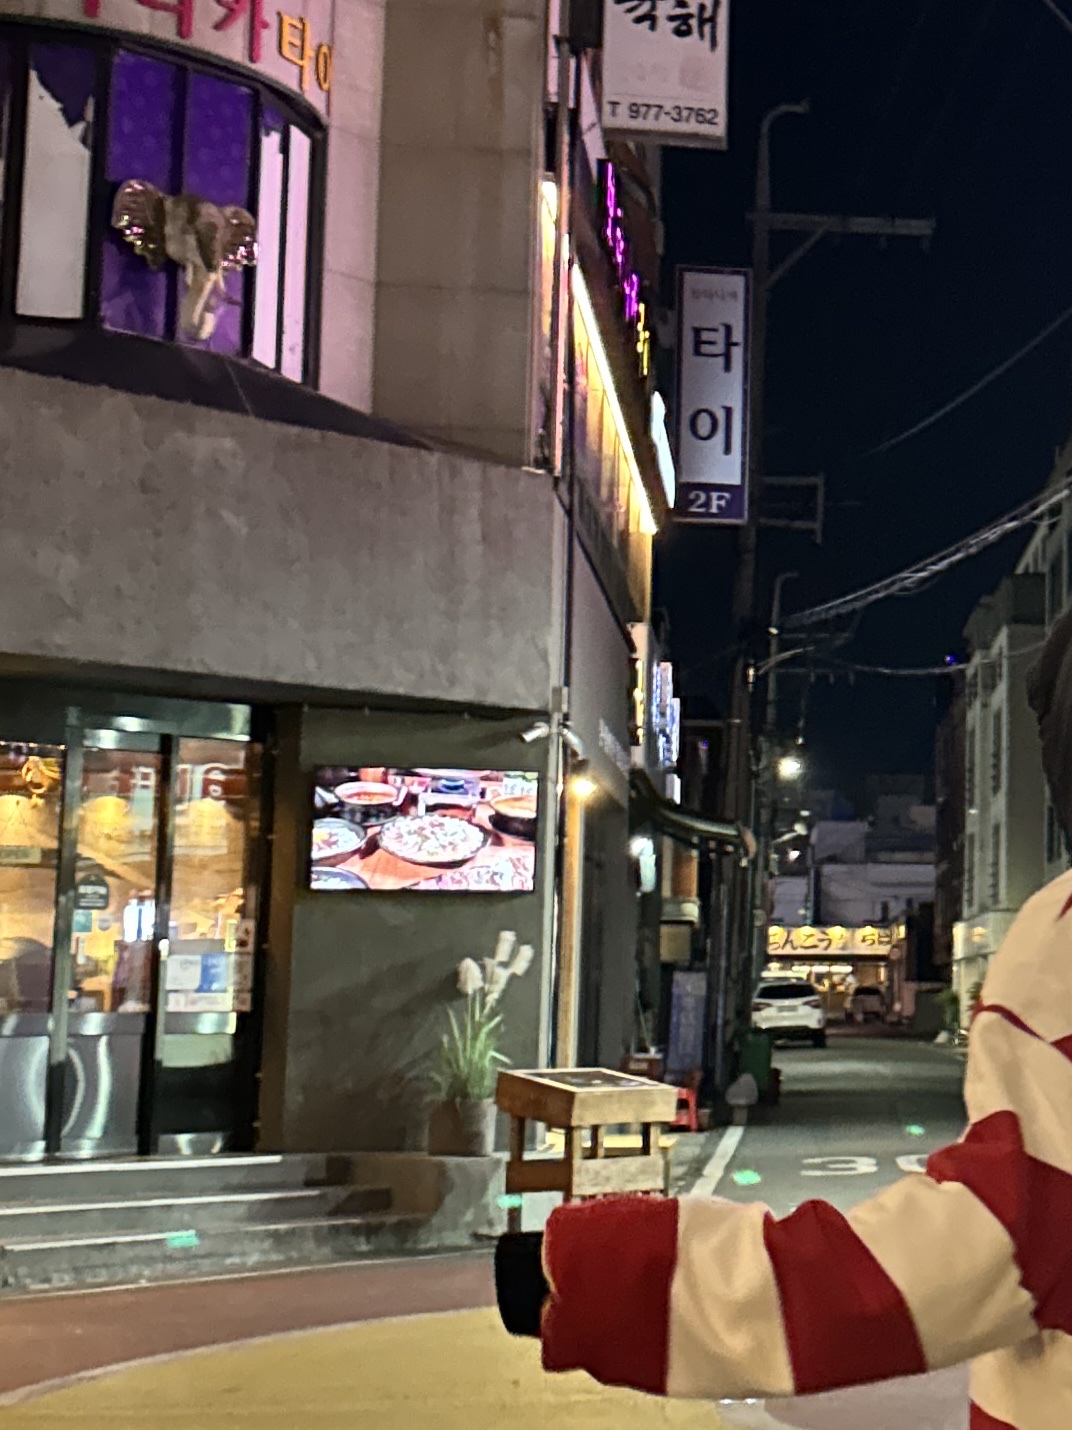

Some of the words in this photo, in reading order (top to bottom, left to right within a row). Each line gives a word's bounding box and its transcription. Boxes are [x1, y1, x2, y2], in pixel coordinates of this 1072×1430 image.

[608, 101, 620, 117] T
[628, 103, 719, 125] 977-3762
[689, 322, 741, 456] 타이
[688, 490, 732, 514] 2F
